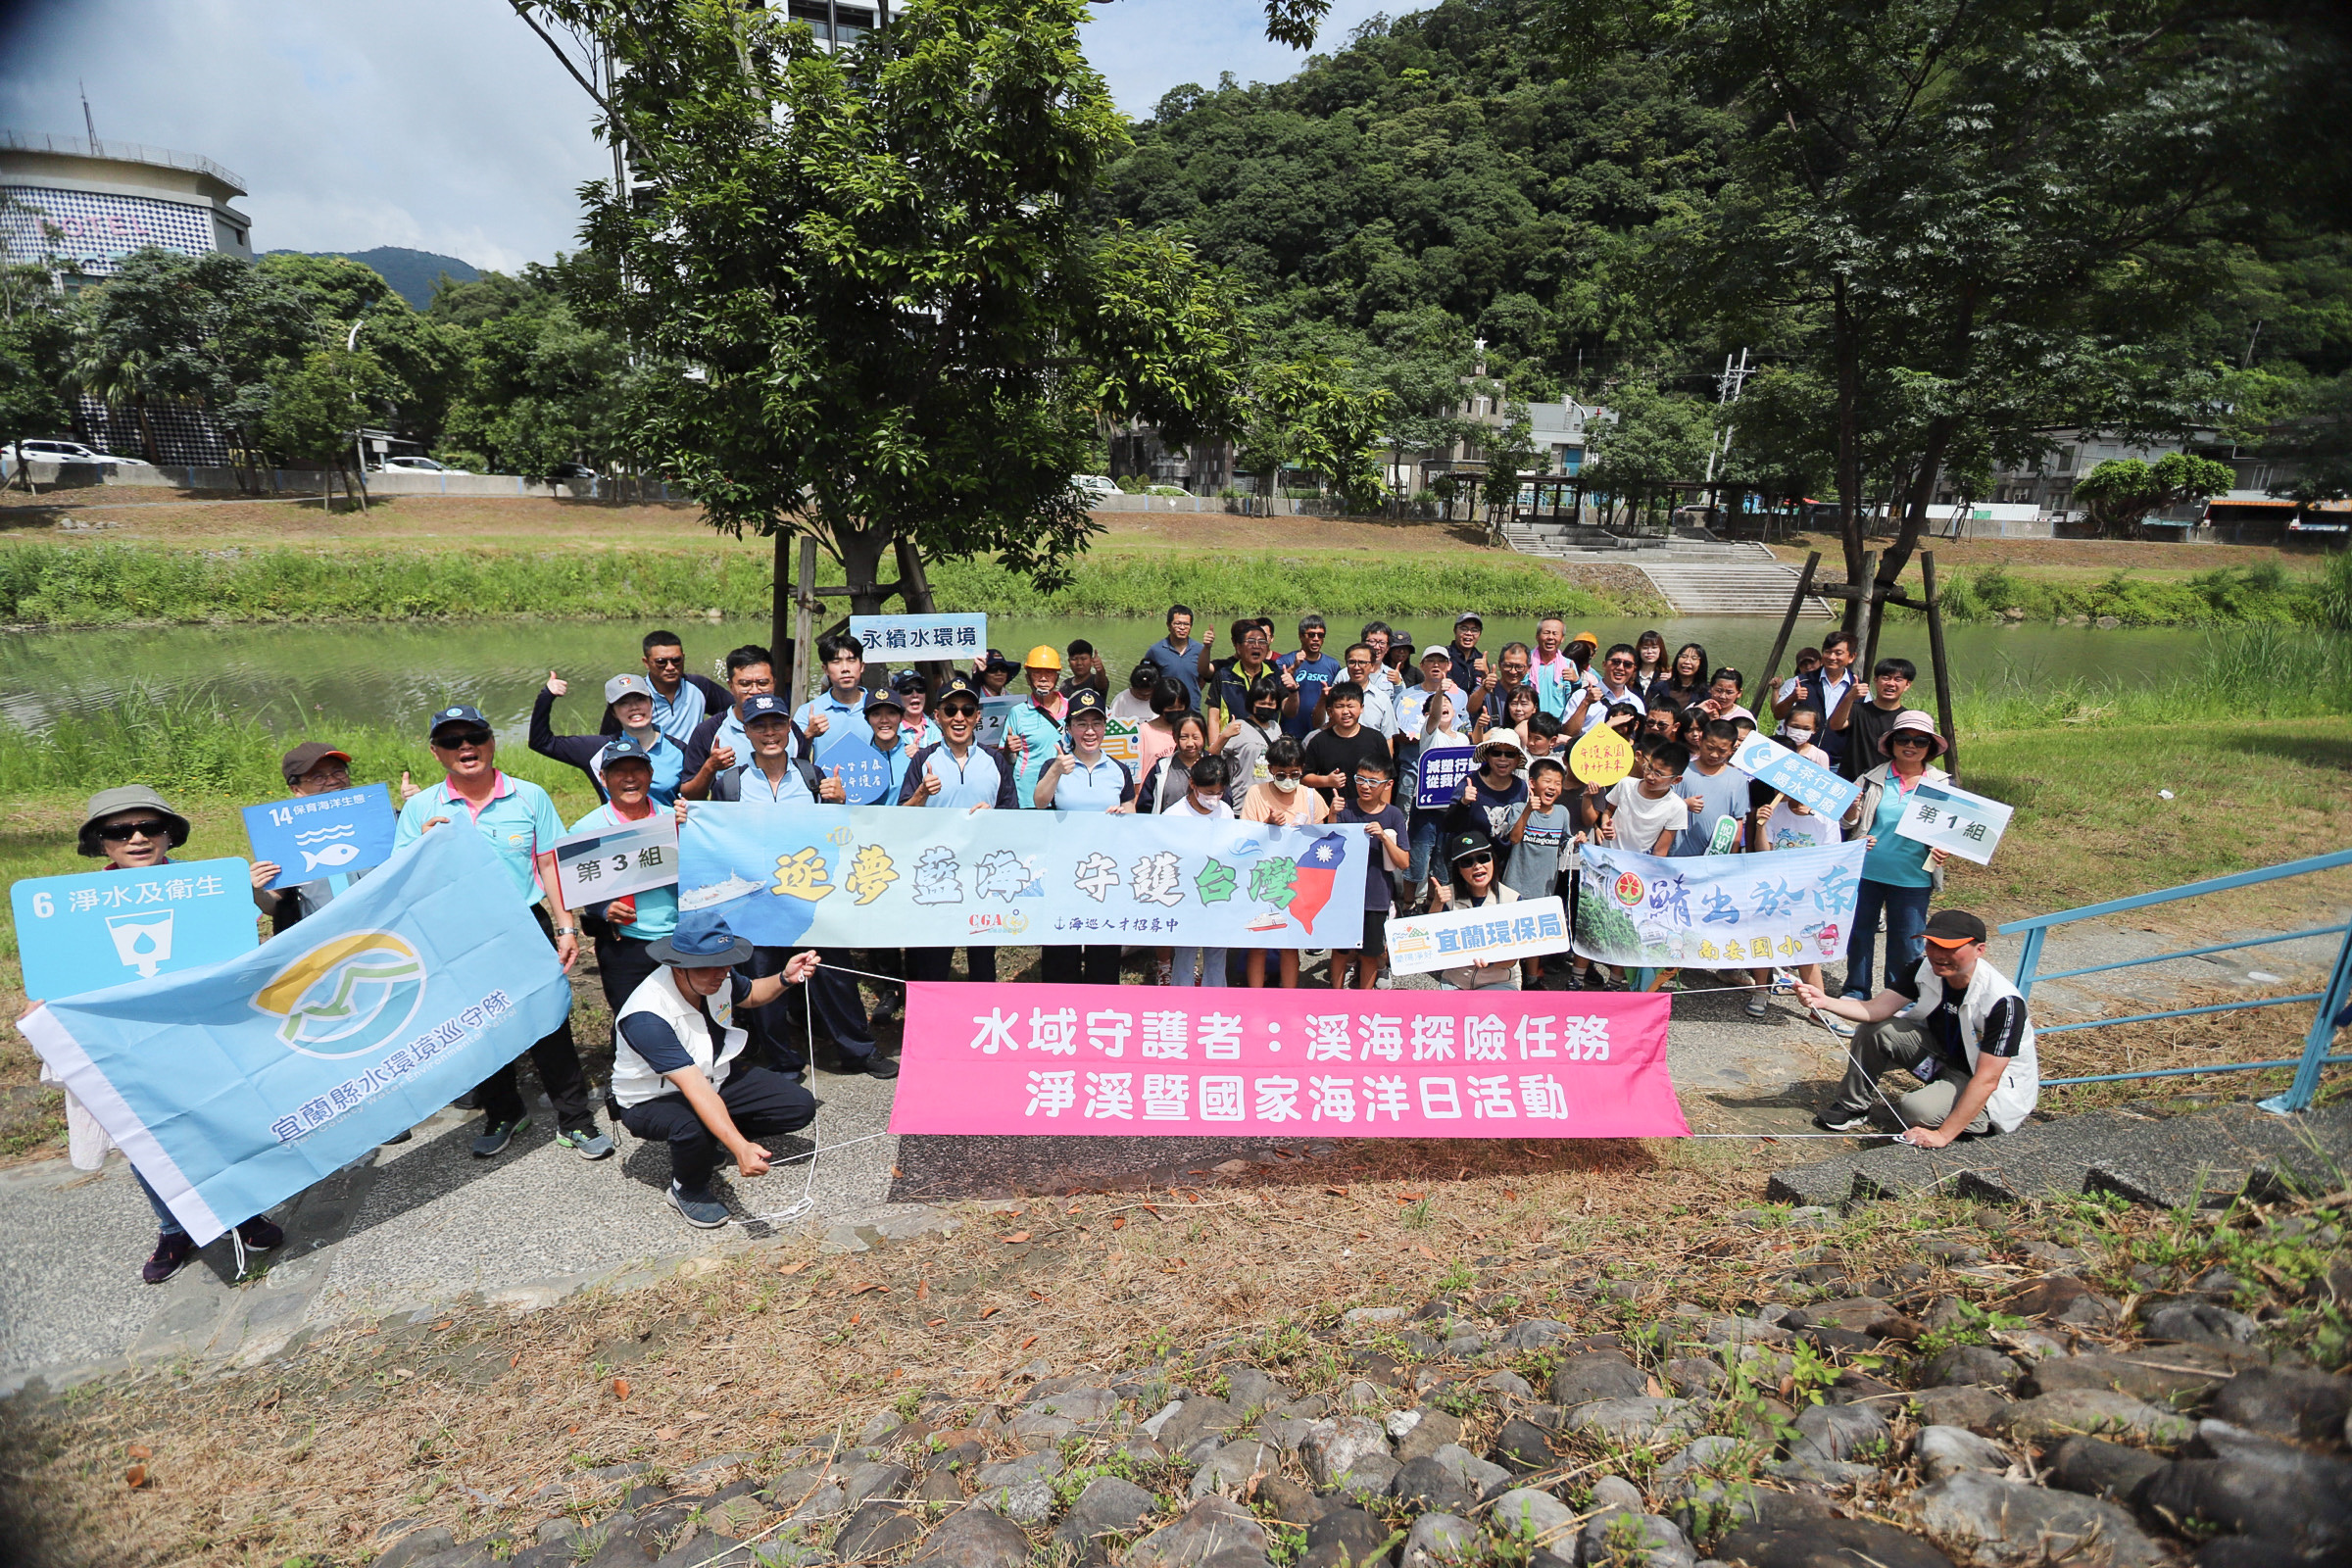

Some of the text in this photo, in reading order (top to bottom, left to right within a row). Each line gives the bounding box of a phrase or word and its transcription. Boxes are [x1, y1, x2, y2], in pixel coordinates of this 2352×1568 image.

[862, 627, 976, 649] 永續水環境
[1307, 673, 1328, 682] asics
[989, 716, 1000, 727] 2
[1581, 744, 1624, 760] 守護家園
[1581, 760, 1624, 775] 淨好未來
[1772, 771, 1838, 815] 喝水零廢
[1784, 757, 1847, 800] 奉茶行動
[269, 794, 366, 827] 14 保育海洋生態
[33, 875, 225, 918] 6 淨水及衛生
[770, 844, 1298, 910] 逐夢藍海 守護台灣
[1649, 864, 1860, 927] 鯖出於南
[969, 914, 1003, 927] CGA
[1069, 917, 1179, 933] 海巡人才招募中
[1435, 913, 1562, 953] 宜蘭環保局
[1698, 936, 1802, 961] 南安國小
[970, 1006, 1610, 1061] 水域守護者：溪海探險任務
[271, 990, 512, 1143] 宜蘭縣水環境巡守隊
[282, 1007, 517, 1150] Yilan County Water Environmental Patrol
[1025, 1070, 1568, 1122] 淨溪暨國家海洋日活動
